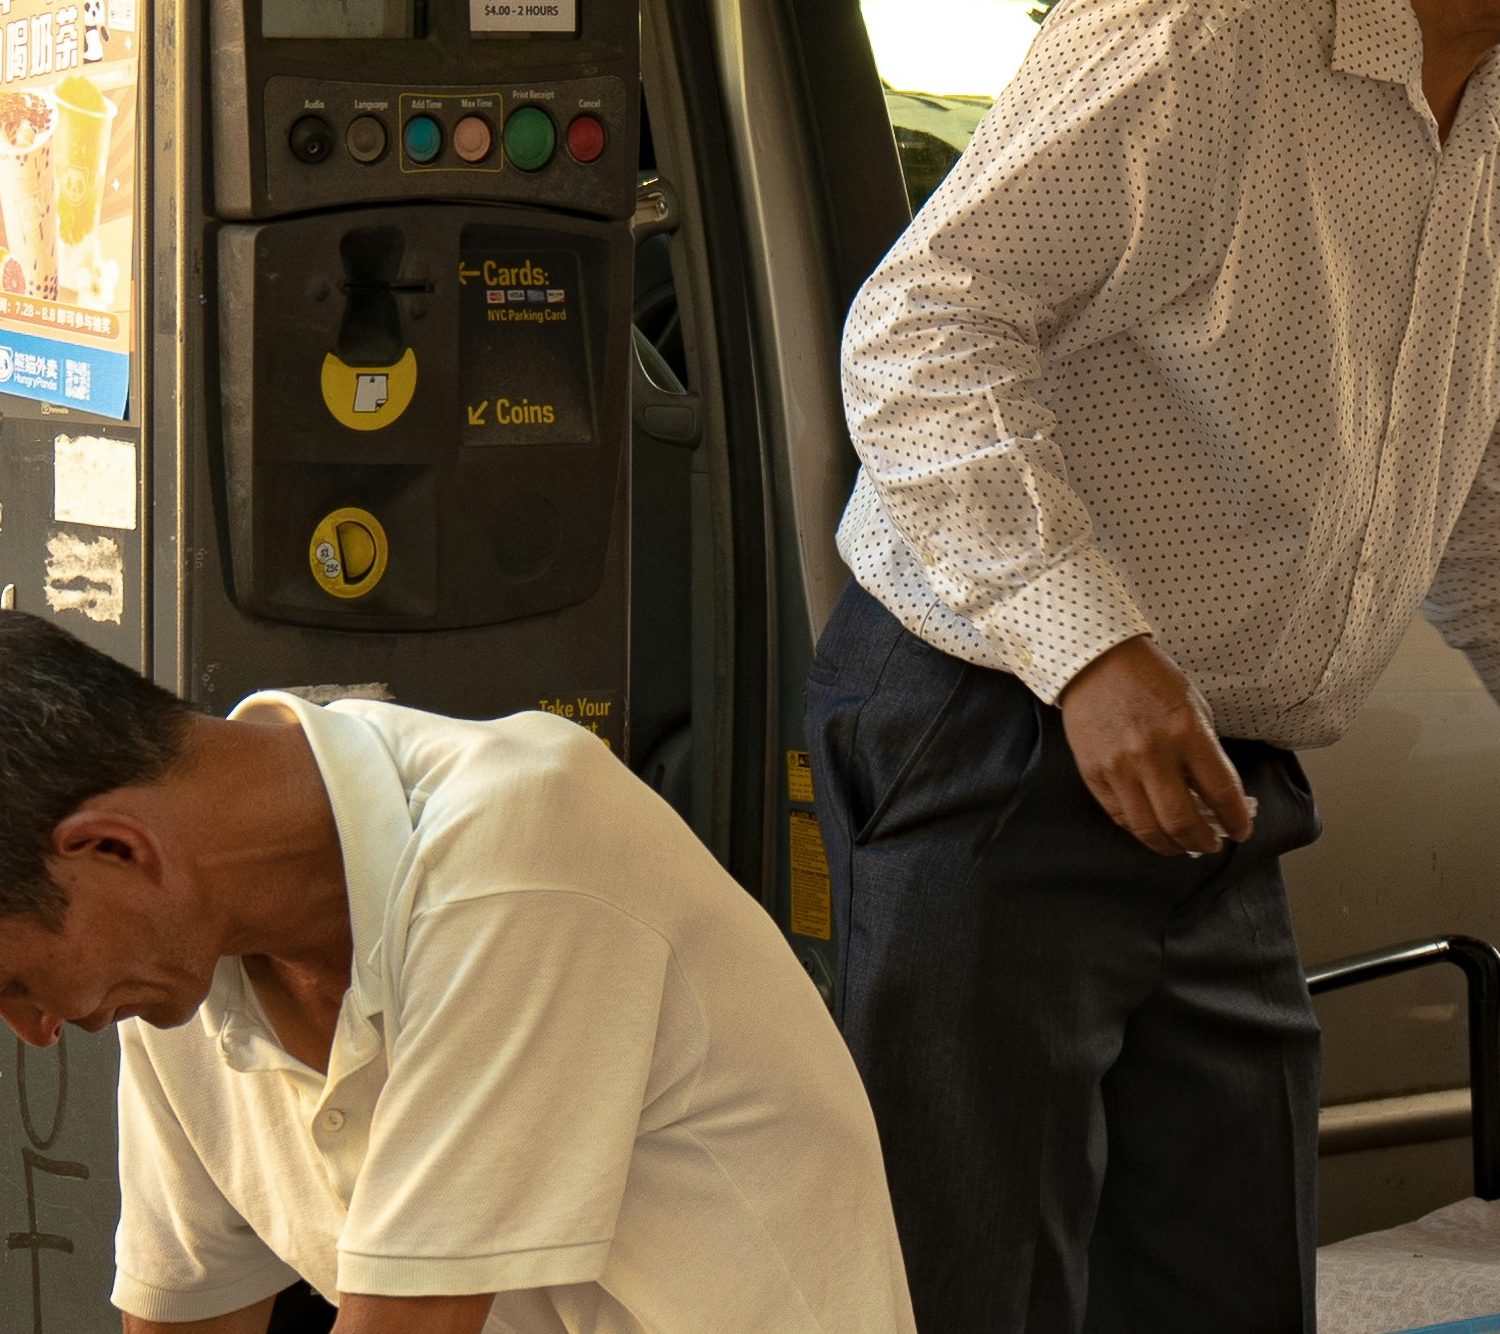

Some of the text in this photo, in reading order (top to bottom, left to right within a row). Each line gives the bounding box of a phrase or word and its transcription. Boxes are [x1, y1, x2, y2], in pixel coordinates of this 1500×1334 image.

[485, 5, 510, 16] $4.00
[526, 6, 558, 16] HOURS
[512, 90, 555, 101] Print Receipt
[304, 99, 324, 110] Audio
[354, 100, 388, 112] Language
[411, 100, 442, 110] Add Time
[461, 98, 493, 109] Max Time
[578, 99, 601, 109] Cancel
[483, 259, 550, 286] Cards:
[487, 309, 567, 324] NYC Parking Card
[496, 398, 555, 425] Coins
